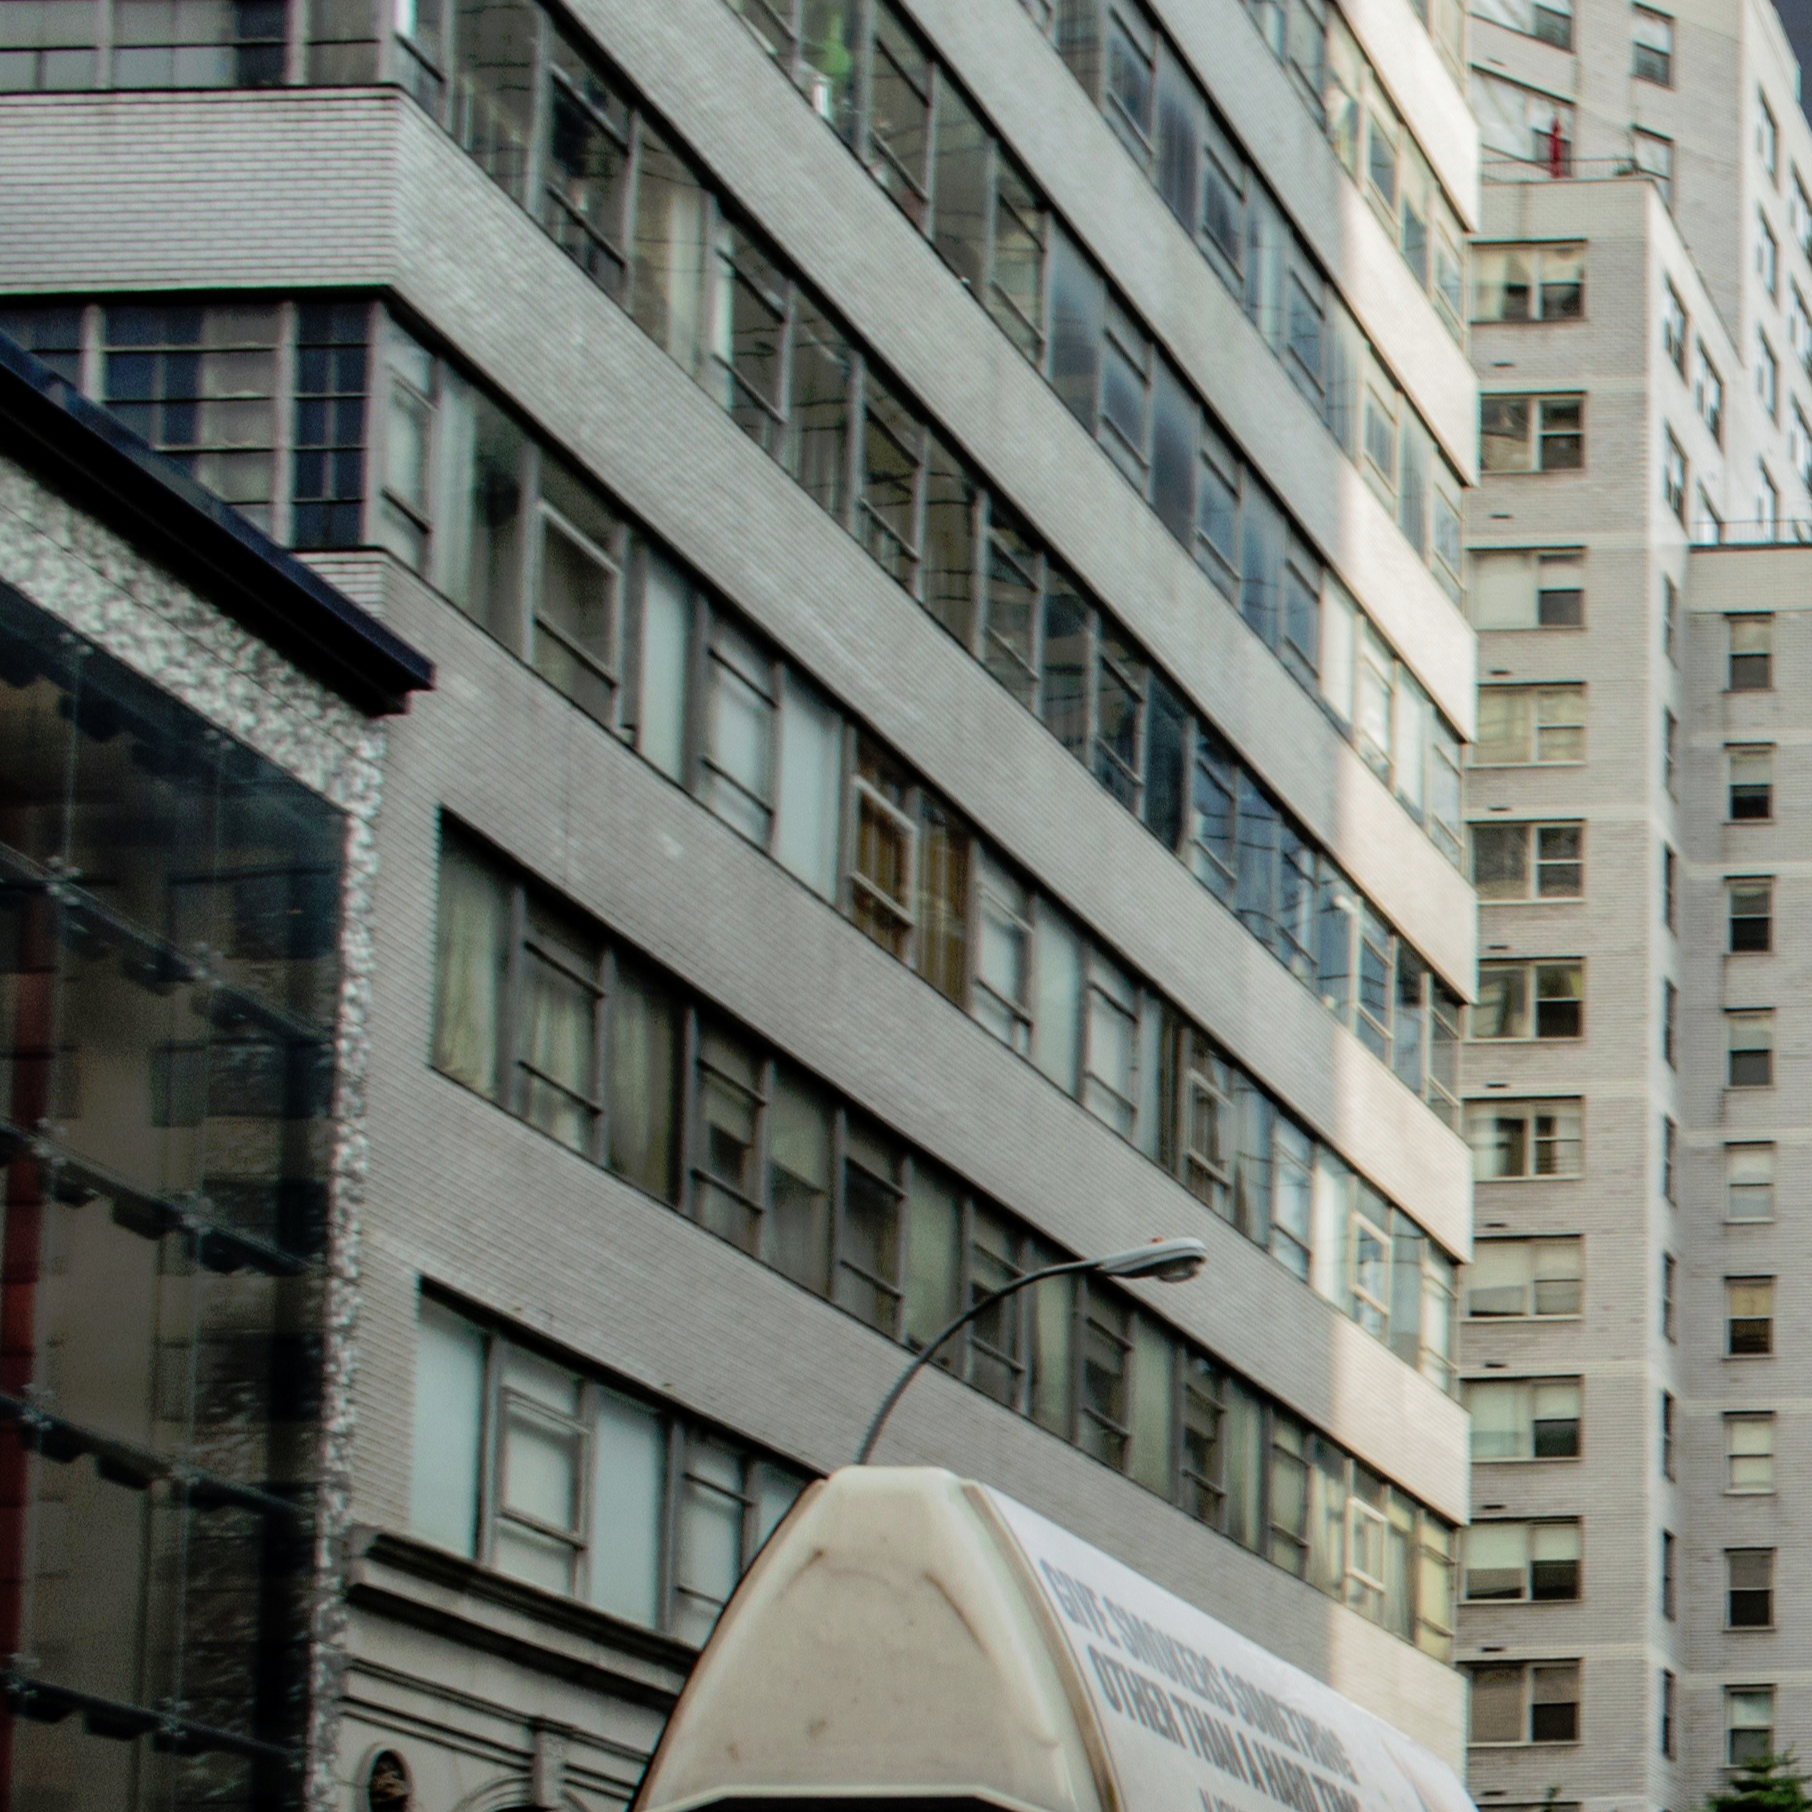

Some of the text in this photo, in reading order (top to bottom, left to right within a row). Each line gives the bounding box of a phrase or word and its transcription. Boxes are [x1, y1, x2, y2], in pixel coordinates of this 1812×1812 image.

[1039, 1557, 1361, 1786] GIVE SMOKERS SOMETHING
[1086, 1643, 1188, 1750] OTHER
[1168, 1690, 1250, 1785] THAN
[1236, 1730, 1268, 1796] A
